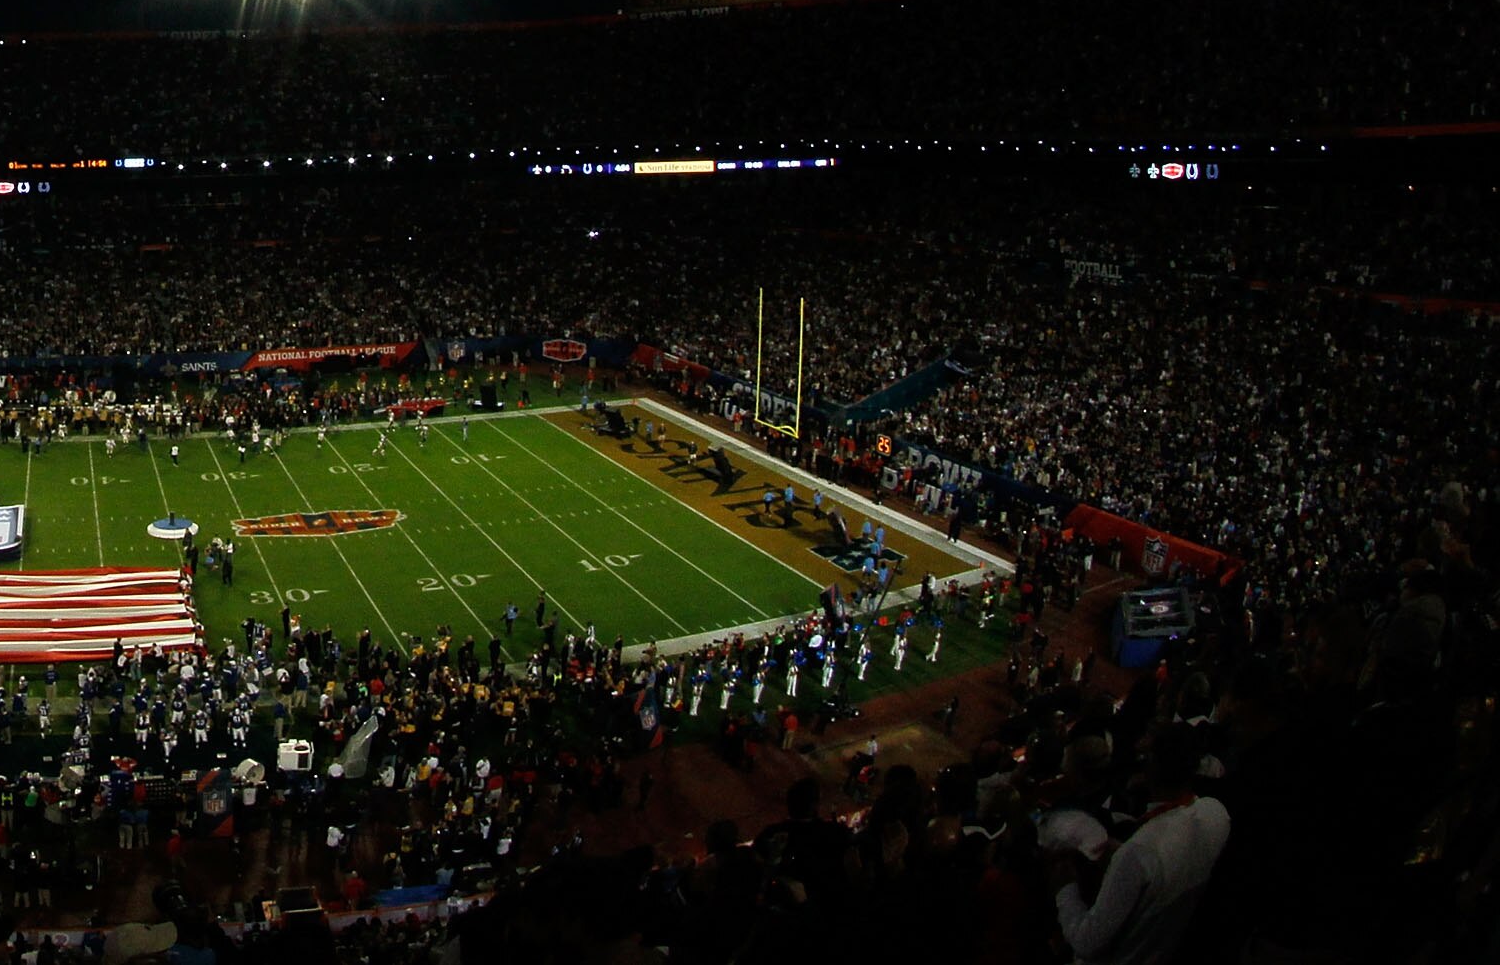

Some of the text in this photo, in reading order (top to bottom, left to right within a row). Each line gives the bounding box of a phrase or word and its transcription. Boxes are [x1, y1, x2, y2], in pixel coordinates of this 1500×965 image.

[258, 352, 308, 362] NATIONAL
[181, 361, 217, 373] SAINTS
[877, 436, 890, 454] 25
[577, 554, 631, 572] 10
[416, 573, 477, 592] 20
[249, 588, 311, 605] 30
